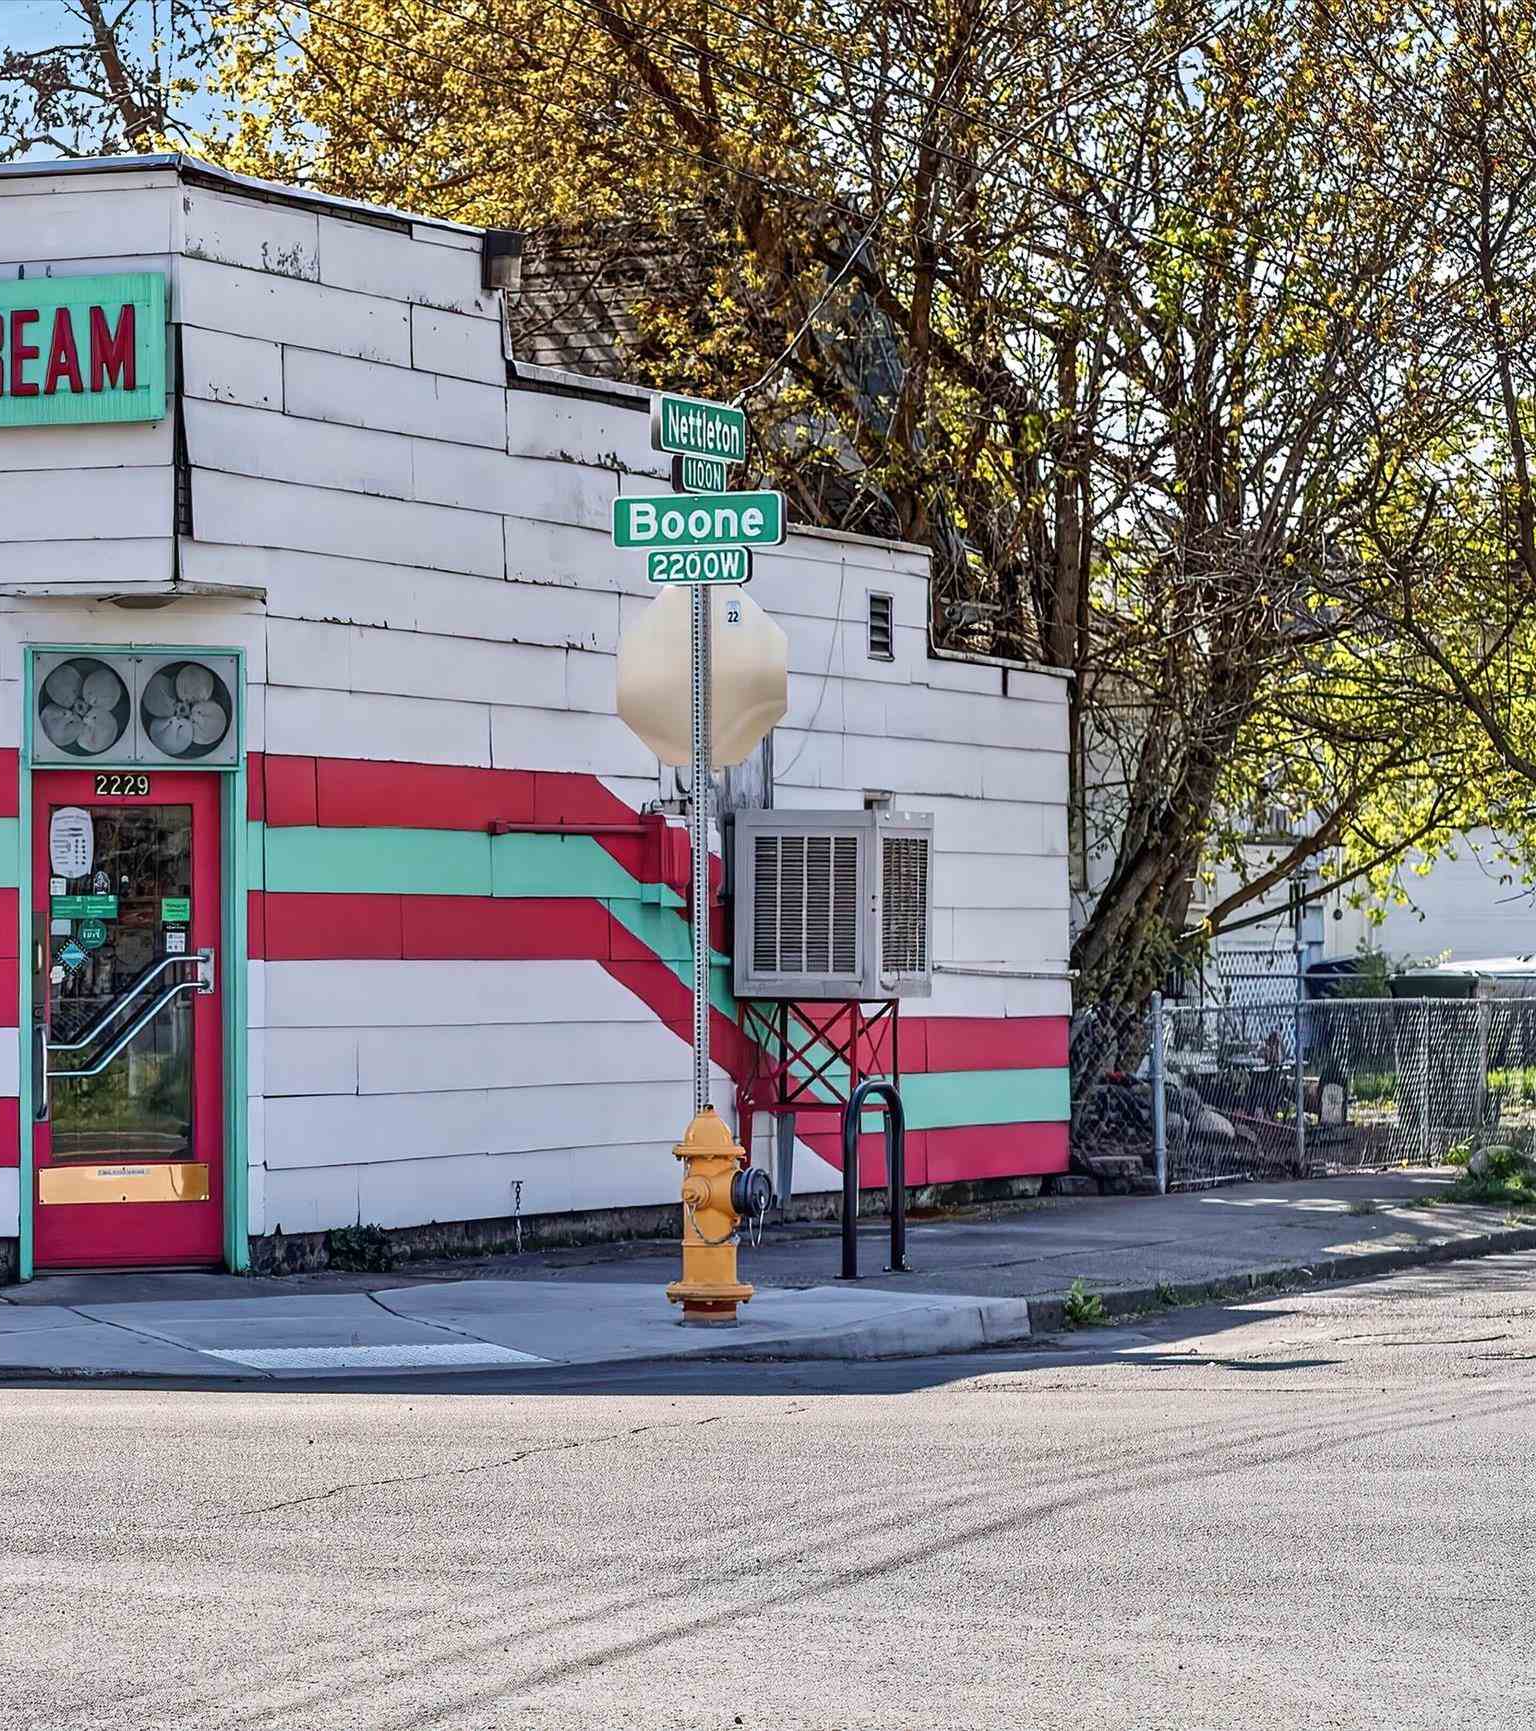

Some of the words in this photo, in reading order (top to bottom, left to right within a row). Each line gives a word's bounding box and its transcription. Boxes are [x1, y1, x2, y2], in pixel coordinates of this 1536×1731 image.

[668, 403, 740, 455] Nettleton
[687, 459, 722, 491] 1100N
[628, 502, 765, 541] Boone
[652, 551, 740, 580] 2200W
[727, 611, 739, 623] 22
[96, 776, 149, 795] 2229
